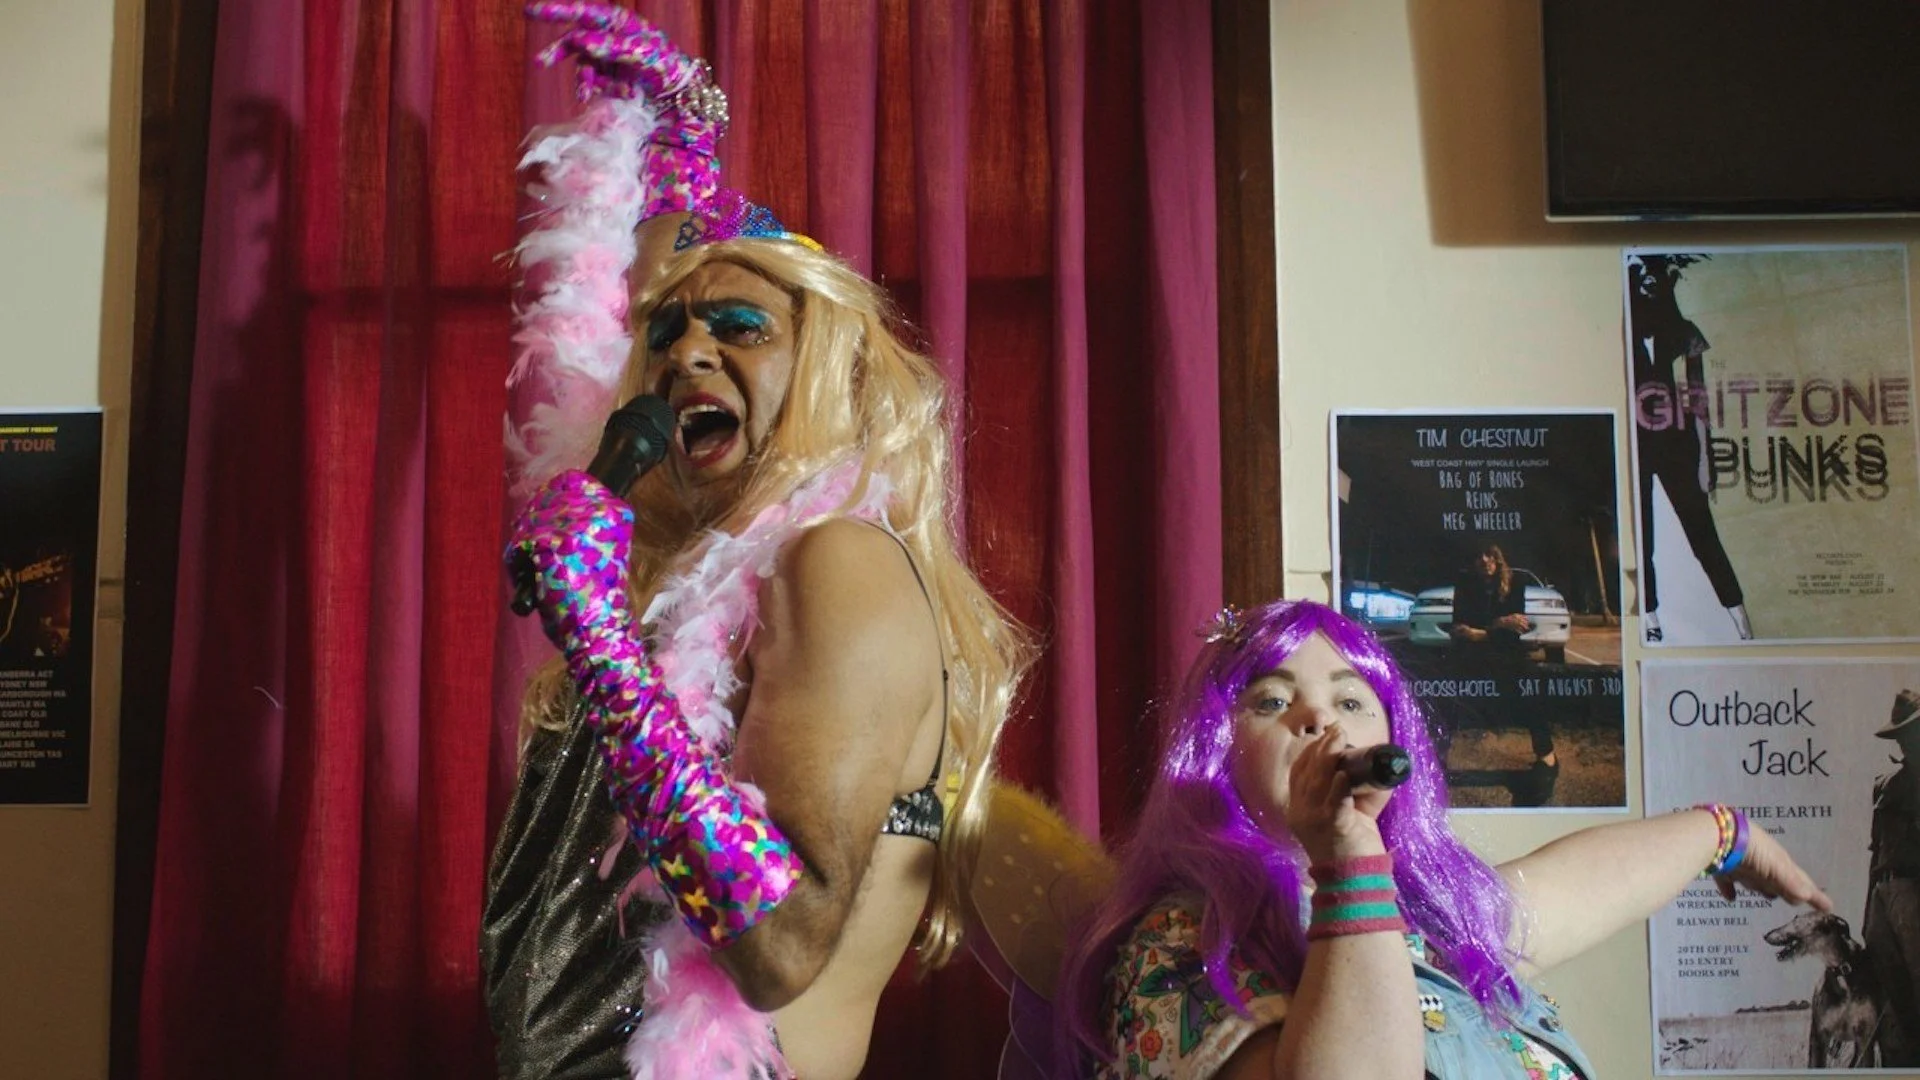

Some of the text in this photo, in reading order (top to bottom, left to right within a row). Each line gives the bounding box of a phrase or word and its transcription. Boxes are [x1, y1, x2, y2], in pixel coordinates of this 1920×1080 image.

[1635, 374, 1911, 431] GRITZONE
[1416, 428, 1549, 448] TIM CHESTNUT
[12, 438, 56, 453] TOUR
[1436, 459, 1463, 468] COAST
[1486, 459, 1514, 468] SINGLE
[1515, 459, 1549, 468] LAUNCH
[1707, 433, 1891, 505] PUNKS
[1439, 470, 1525, 489] BAG OF BONES
[1466, 491, 1498, 509] REINS
[1443, 512, 1522, 530] MEG WHEELER
[37, 670, 54, 678] ACT
[29, 680, 48, 688] NSW
[1414, 680, 1457, 697] CROSS
[1459, 680, 1500, 697] HOTEL
[1518, 679, 1541, 696] SAT
[1548, 679, 1593, 696] AUGUST
[1602, 679, 1621, 696] 3RD
[33, 700, 47, 708] WA
[1669, 688, 1816, 726] Outback
[1, 710, 29, 718] COAST
[24, 740, 36, 748] SA
[1742, 738, 1830, 777] Jack
[1738, 806, 1772, 819] THE
[1775, 805, 1832, 818] EARTH
[1677, 900, 1773, 909] WRECKING TRAIN
[1724, 917, 1749, 926] BELL
[1677, 945, 1749, 955] 20TH OF JULY
[1678, 957, 1734, 966] $15 ENTRY
[1678, 969, 1740, 978] DOORS 8PM
